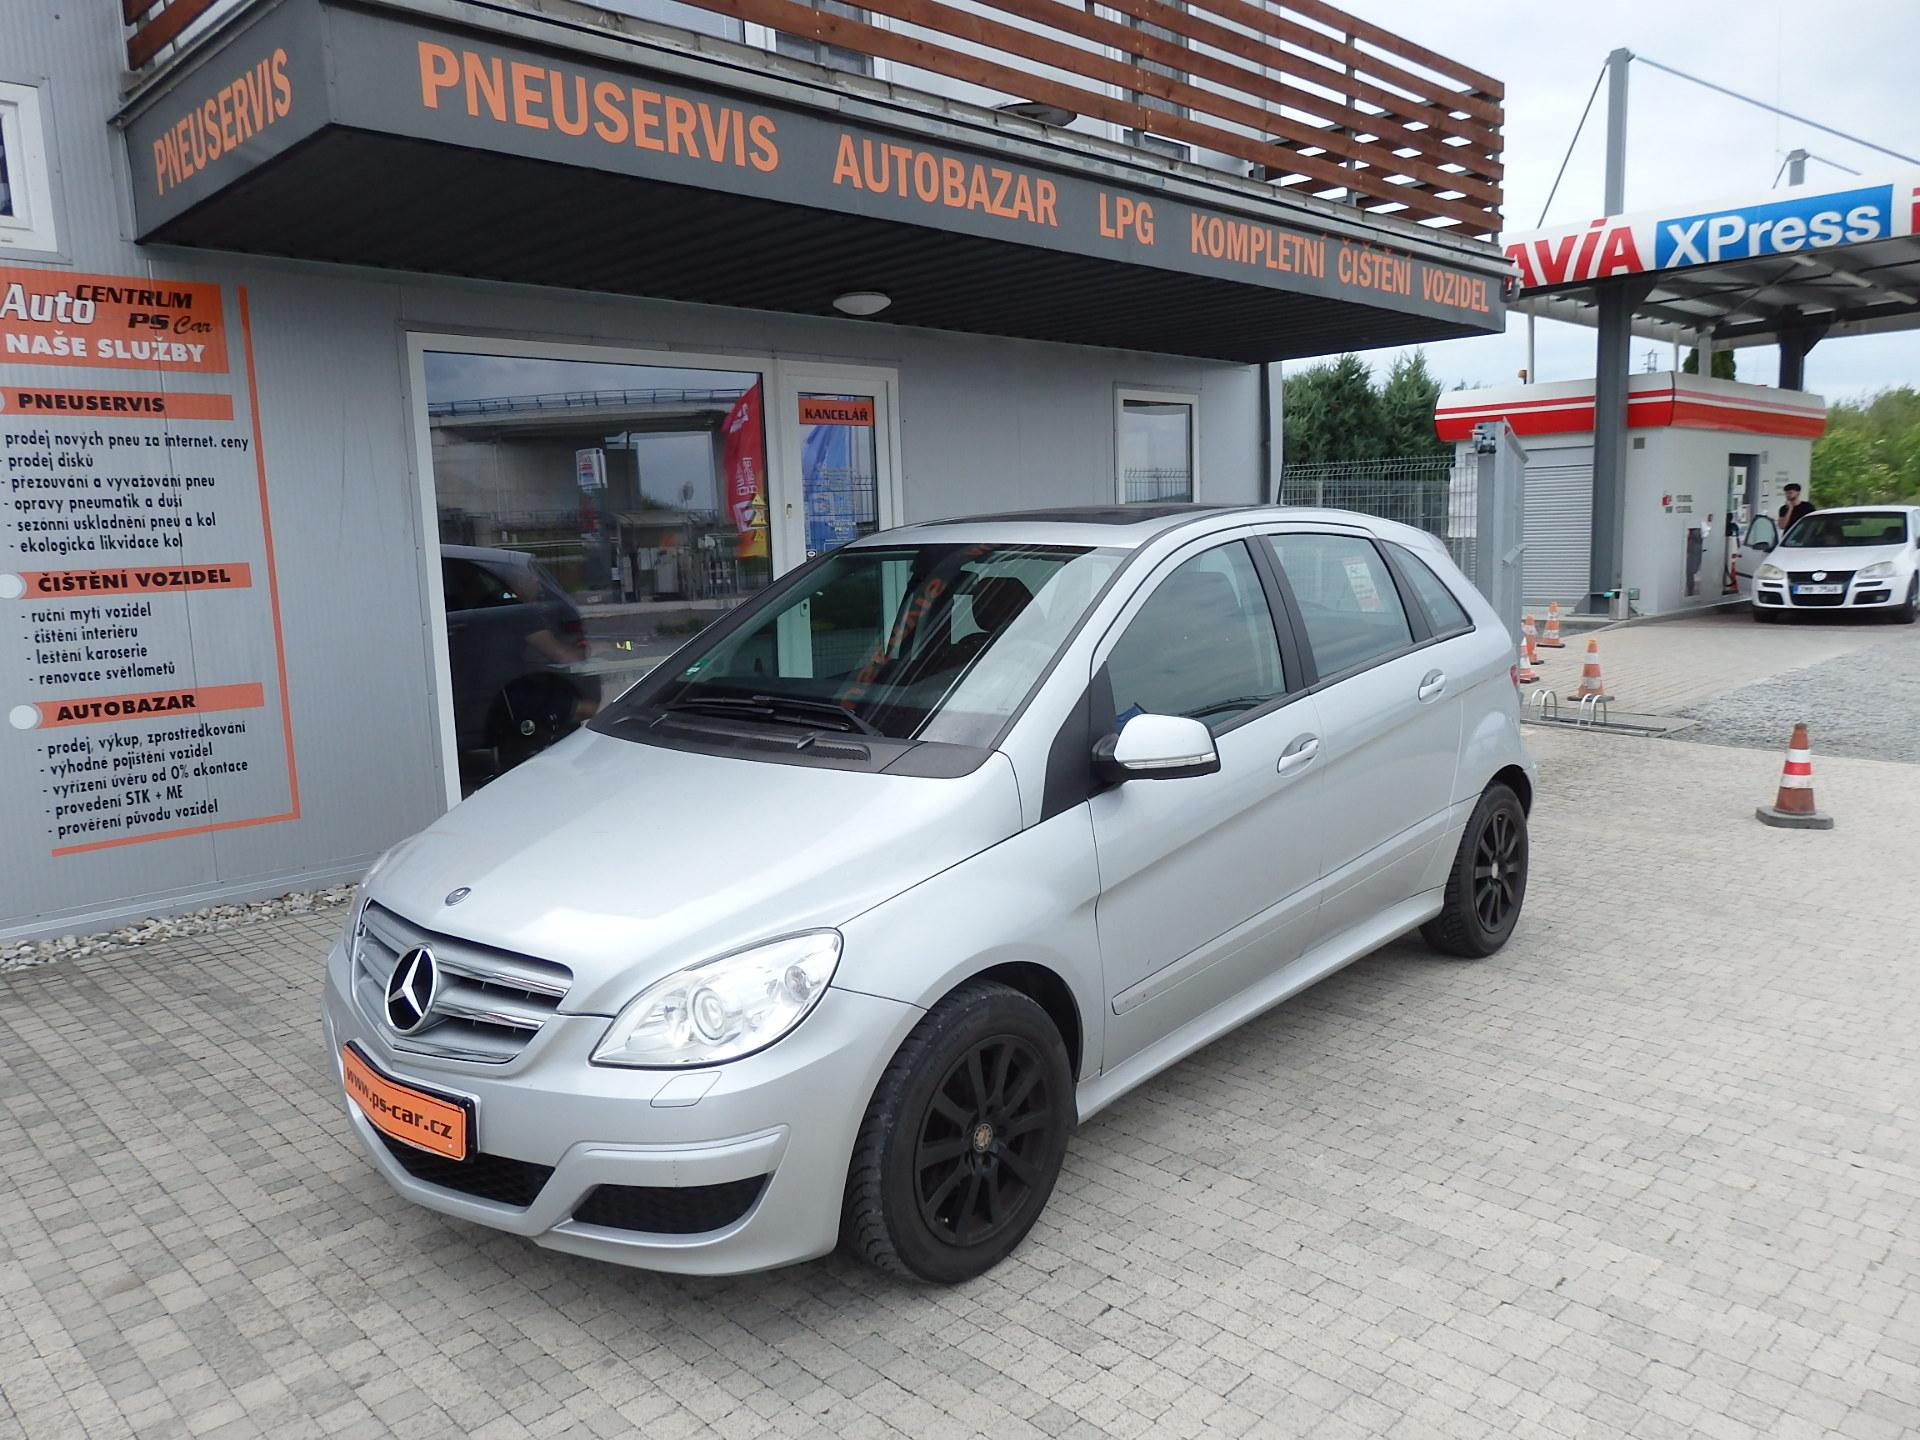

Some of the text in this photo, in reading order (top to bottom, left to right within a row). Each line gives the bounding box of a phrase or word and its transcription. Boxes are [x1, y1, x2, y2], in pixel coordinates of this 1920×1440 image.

[153, 48, 292, 196] PNEUSERVIS
[417, 41, 1489, 313] PNEUSERVIS AUTOBAZAR LPG KOMPLETNÍ ČIŠTĚNÍ VOZIDEL
[1664, 205, 1881, 267] XPress
[0, 282, 192, 324] Auto CENTRUM
[128, 312, 213, 335] PS Car
[5, 329, 205, 363] NAŠE SLUŽBY
[18, 393, 165, 413] PNEUSERVIS
[804, 407, 869, 421] KANCELÁŘ
[5, 430, 249, 452] prodej nových pneu za internet. ceny
[8, 452, 94, 471] prodej disků
[12, 474, 215, 492] přezouvání a vyvažování pneu
[15, 492, 183, 514] opravy pneumatik a duší
[18, 512, 216, 531] sezónní uskladnění pneu a kol
[20, 532, 183, 555] ekologická likvidace kol
[38, 569, 231, 592] ČIŠTĚNÍ VOZIDEL
[31, 601, 152, 623] ruční mytí vozidel
[34, 624, 138, 643] čištění interiéru
[36, 643, 147, 664] leštění karoserie
[39, 661, 175, 685] renovace světlometů
[57, 694, 196, 721] AUTOBAZAR
[147, 721, 246, 746] zprostředkování
[50, 741, 213, 778] výhodné pojištění vozidel
[53, 761, 248, 799] vyřízení úvěru od 0% akontace
[55, 794, 122, 820] provedení
[126, 789, 150, 806] STK
[166, 784, 183, 800] ME
[58, 798, 219, 840] prověření původu vozidel
[346, 1067, 453, 1140] www.ps-car.cz
